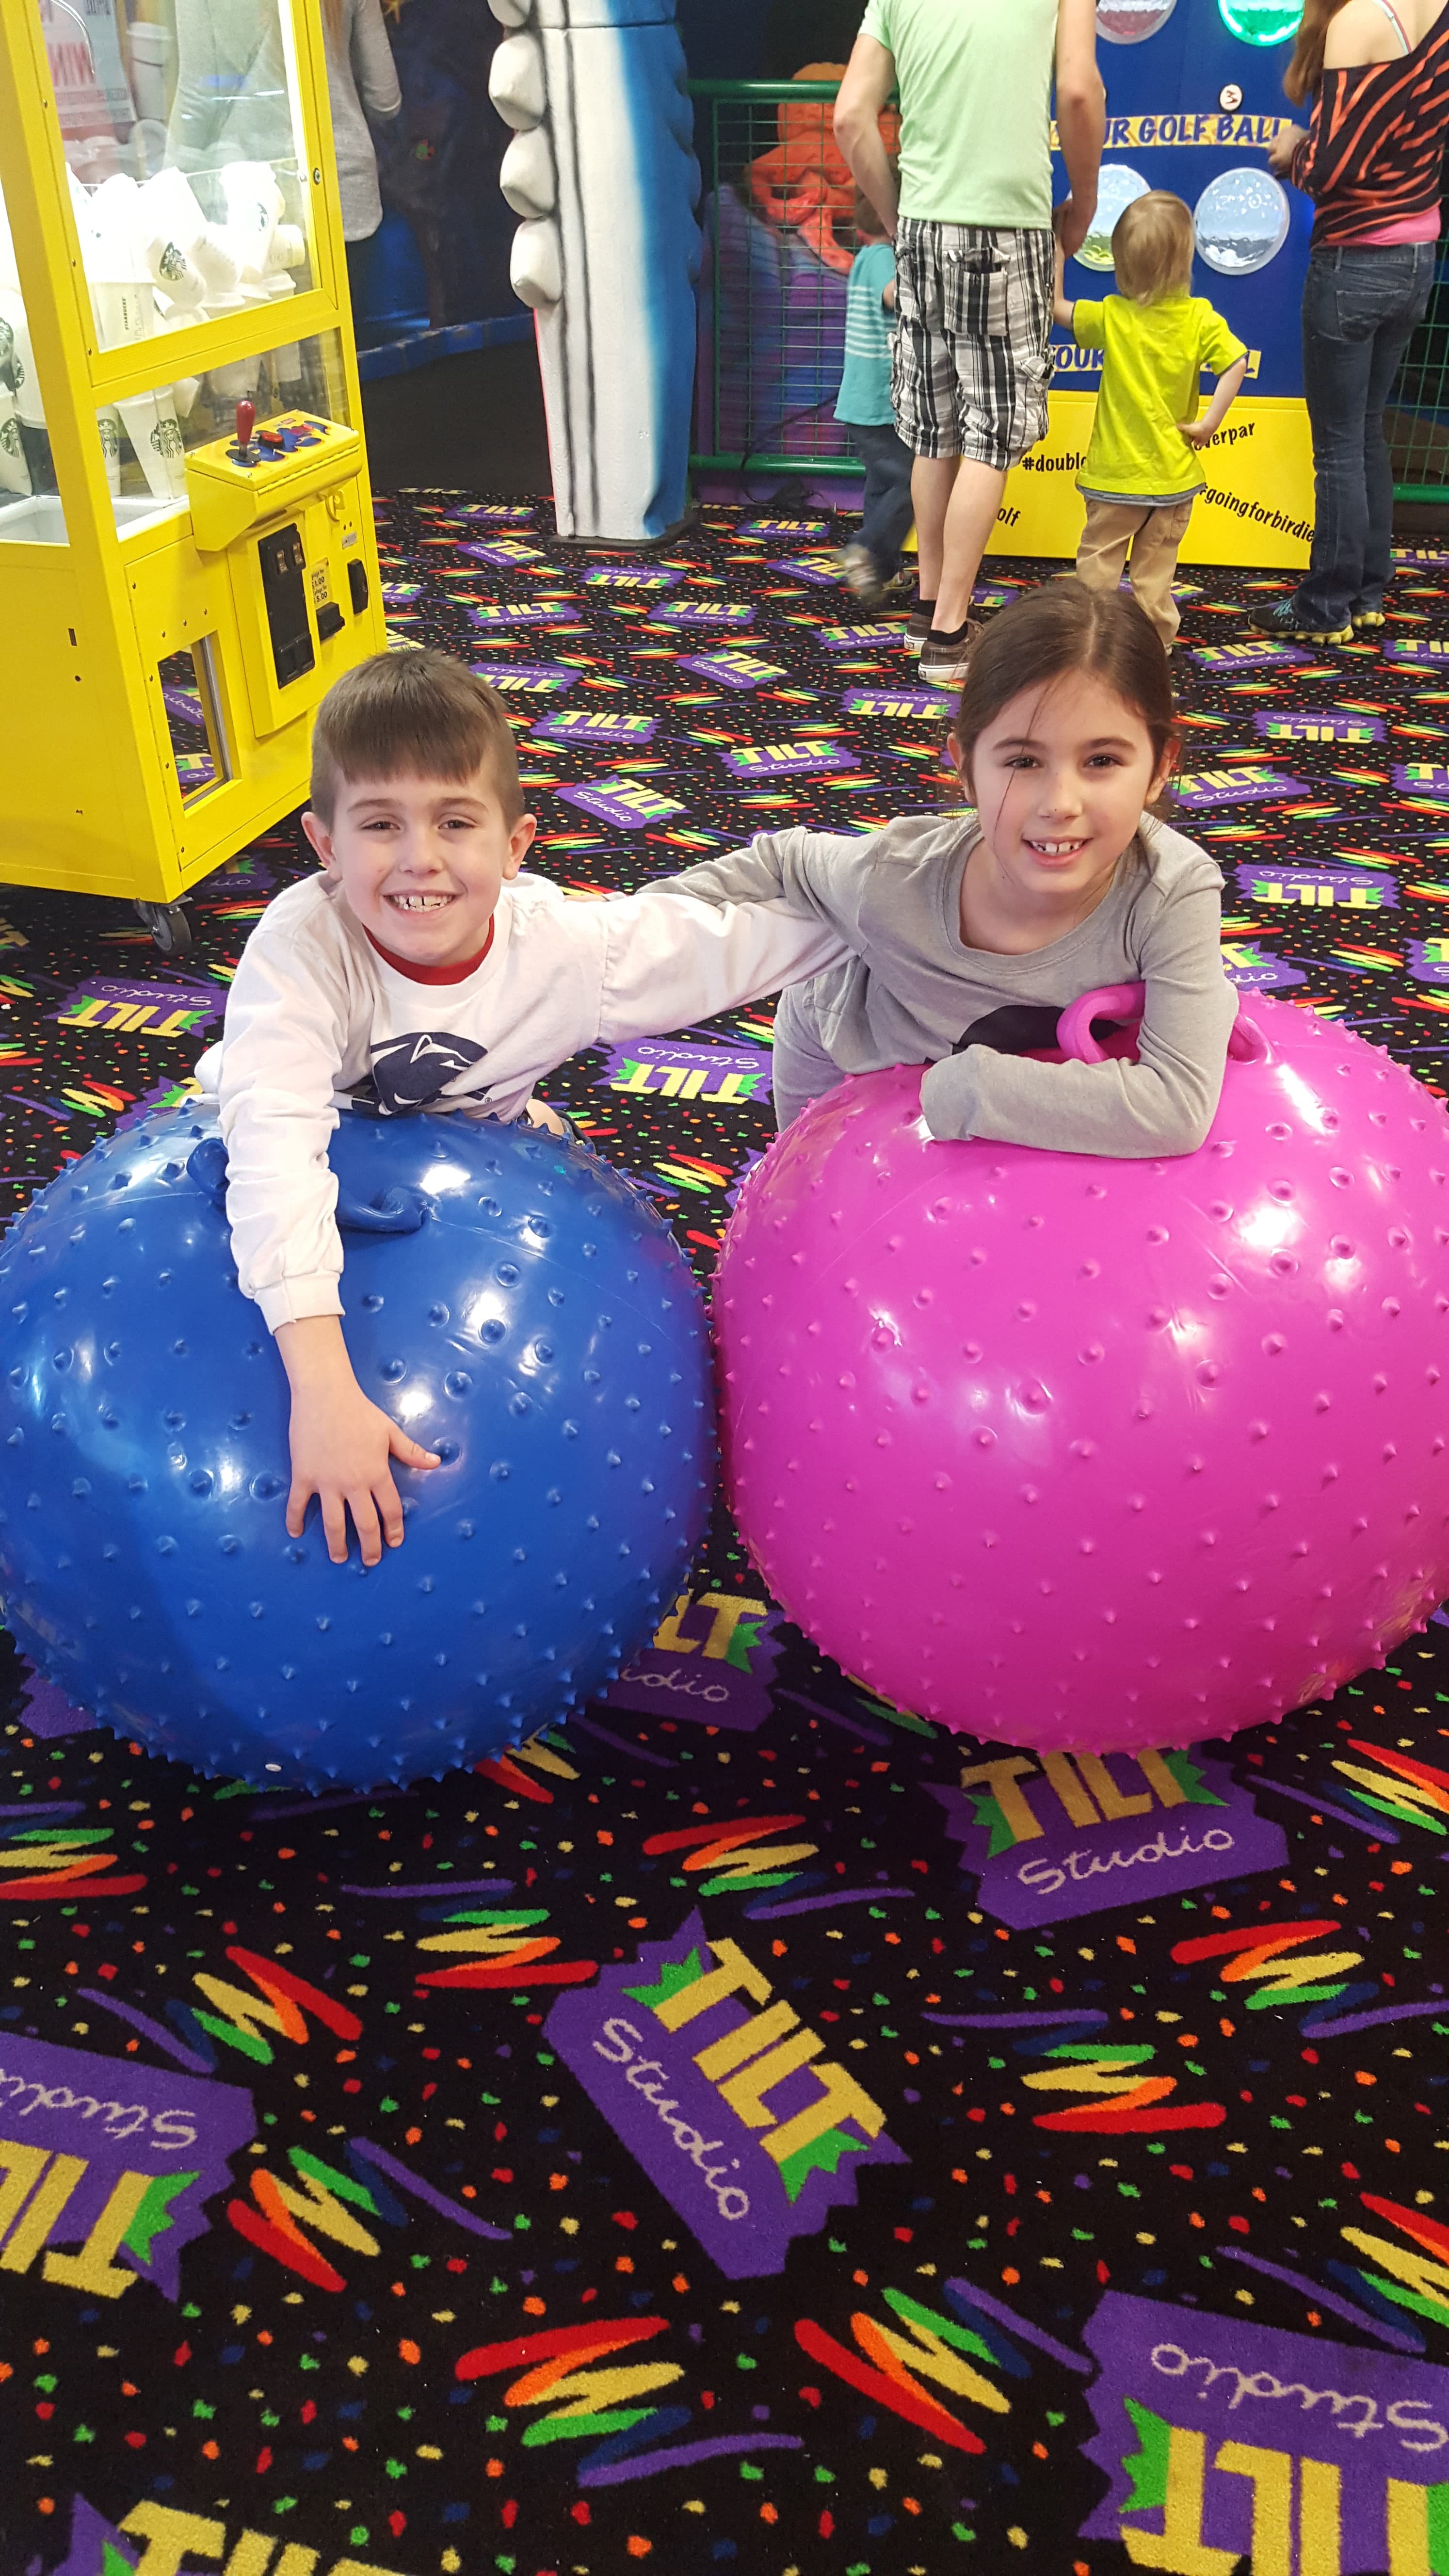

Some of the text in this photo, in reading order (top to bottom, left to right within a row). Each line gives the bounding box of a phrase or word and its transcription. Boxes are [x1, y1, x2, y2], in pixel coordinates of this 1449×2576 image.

[1138, 115, 1210, 144] GOLF
[1051, 345, 1104, 369] OUR
[467, 504, 531, 515] TILT
[997, 507, 1021, 527] olf
[756, 520, 824, 531] TILT
[486, 540, 546, 559] TILT
[1389, 548, 1449, 560] TIL
[586, 574, 663, 589] TILT
[602, 569, 671, 578] Studio
[380, 582, 421, 594] LT
[476, 602, 559, 617] TILT
[486, 614, 565, 623] Studio
[663, 613, 738, 622] Studio
[674, 602, 751, 616] TILT
[823, 622, 901, 639] TILT
[838, 634, 906, 646] Studi
[1193, 641, 1277, 660] TILT
[1217, 654, 1296, 666] Studio
[486, 667, 564, 677] Studio
[692, 660, 745, 683] Studio
[725, 651, 785, 677] TILT
[862, 693, 948, 703] Studio
[560, 710, 654, 730] TILT
[849, 702, 944, 720] TILT
[1273, 716, 1367, 726] Studio
[549, 725, 635, 739] Studio
[1267, 725, 1371, 743] TILT
[731, 740, 825, 763] TILT
[747, 757, 840, 774] Studio
[1168, 766, 1262, 792] TILT
[611, 779, 684, 814] TILT
[1192, 786, 1288, 802] Studio
[574, 789, 634, 821] Studio
[1259, 871, 1373, 885] Studio
[1253, 884, 1380, 910] TILT
[101, 985, 211, 1006] Studio
[57, 1000, 187, 1038] TILT
[637, 1046, 760, 1069] Studio
[611, 1064, 748, 1104] TILT
[653, 1588, 768, 1660] LT
[1018, 1830, 1232, 1893] Studio
[653, 1938, 886, 2165] TILT
[0, 2068, 198, 2150] Studi
[593, 2018, 748, 2220] Studio
[0, 2139, 154, 2299] TIL
[1151, 2344, 1449, 2452] Studio
